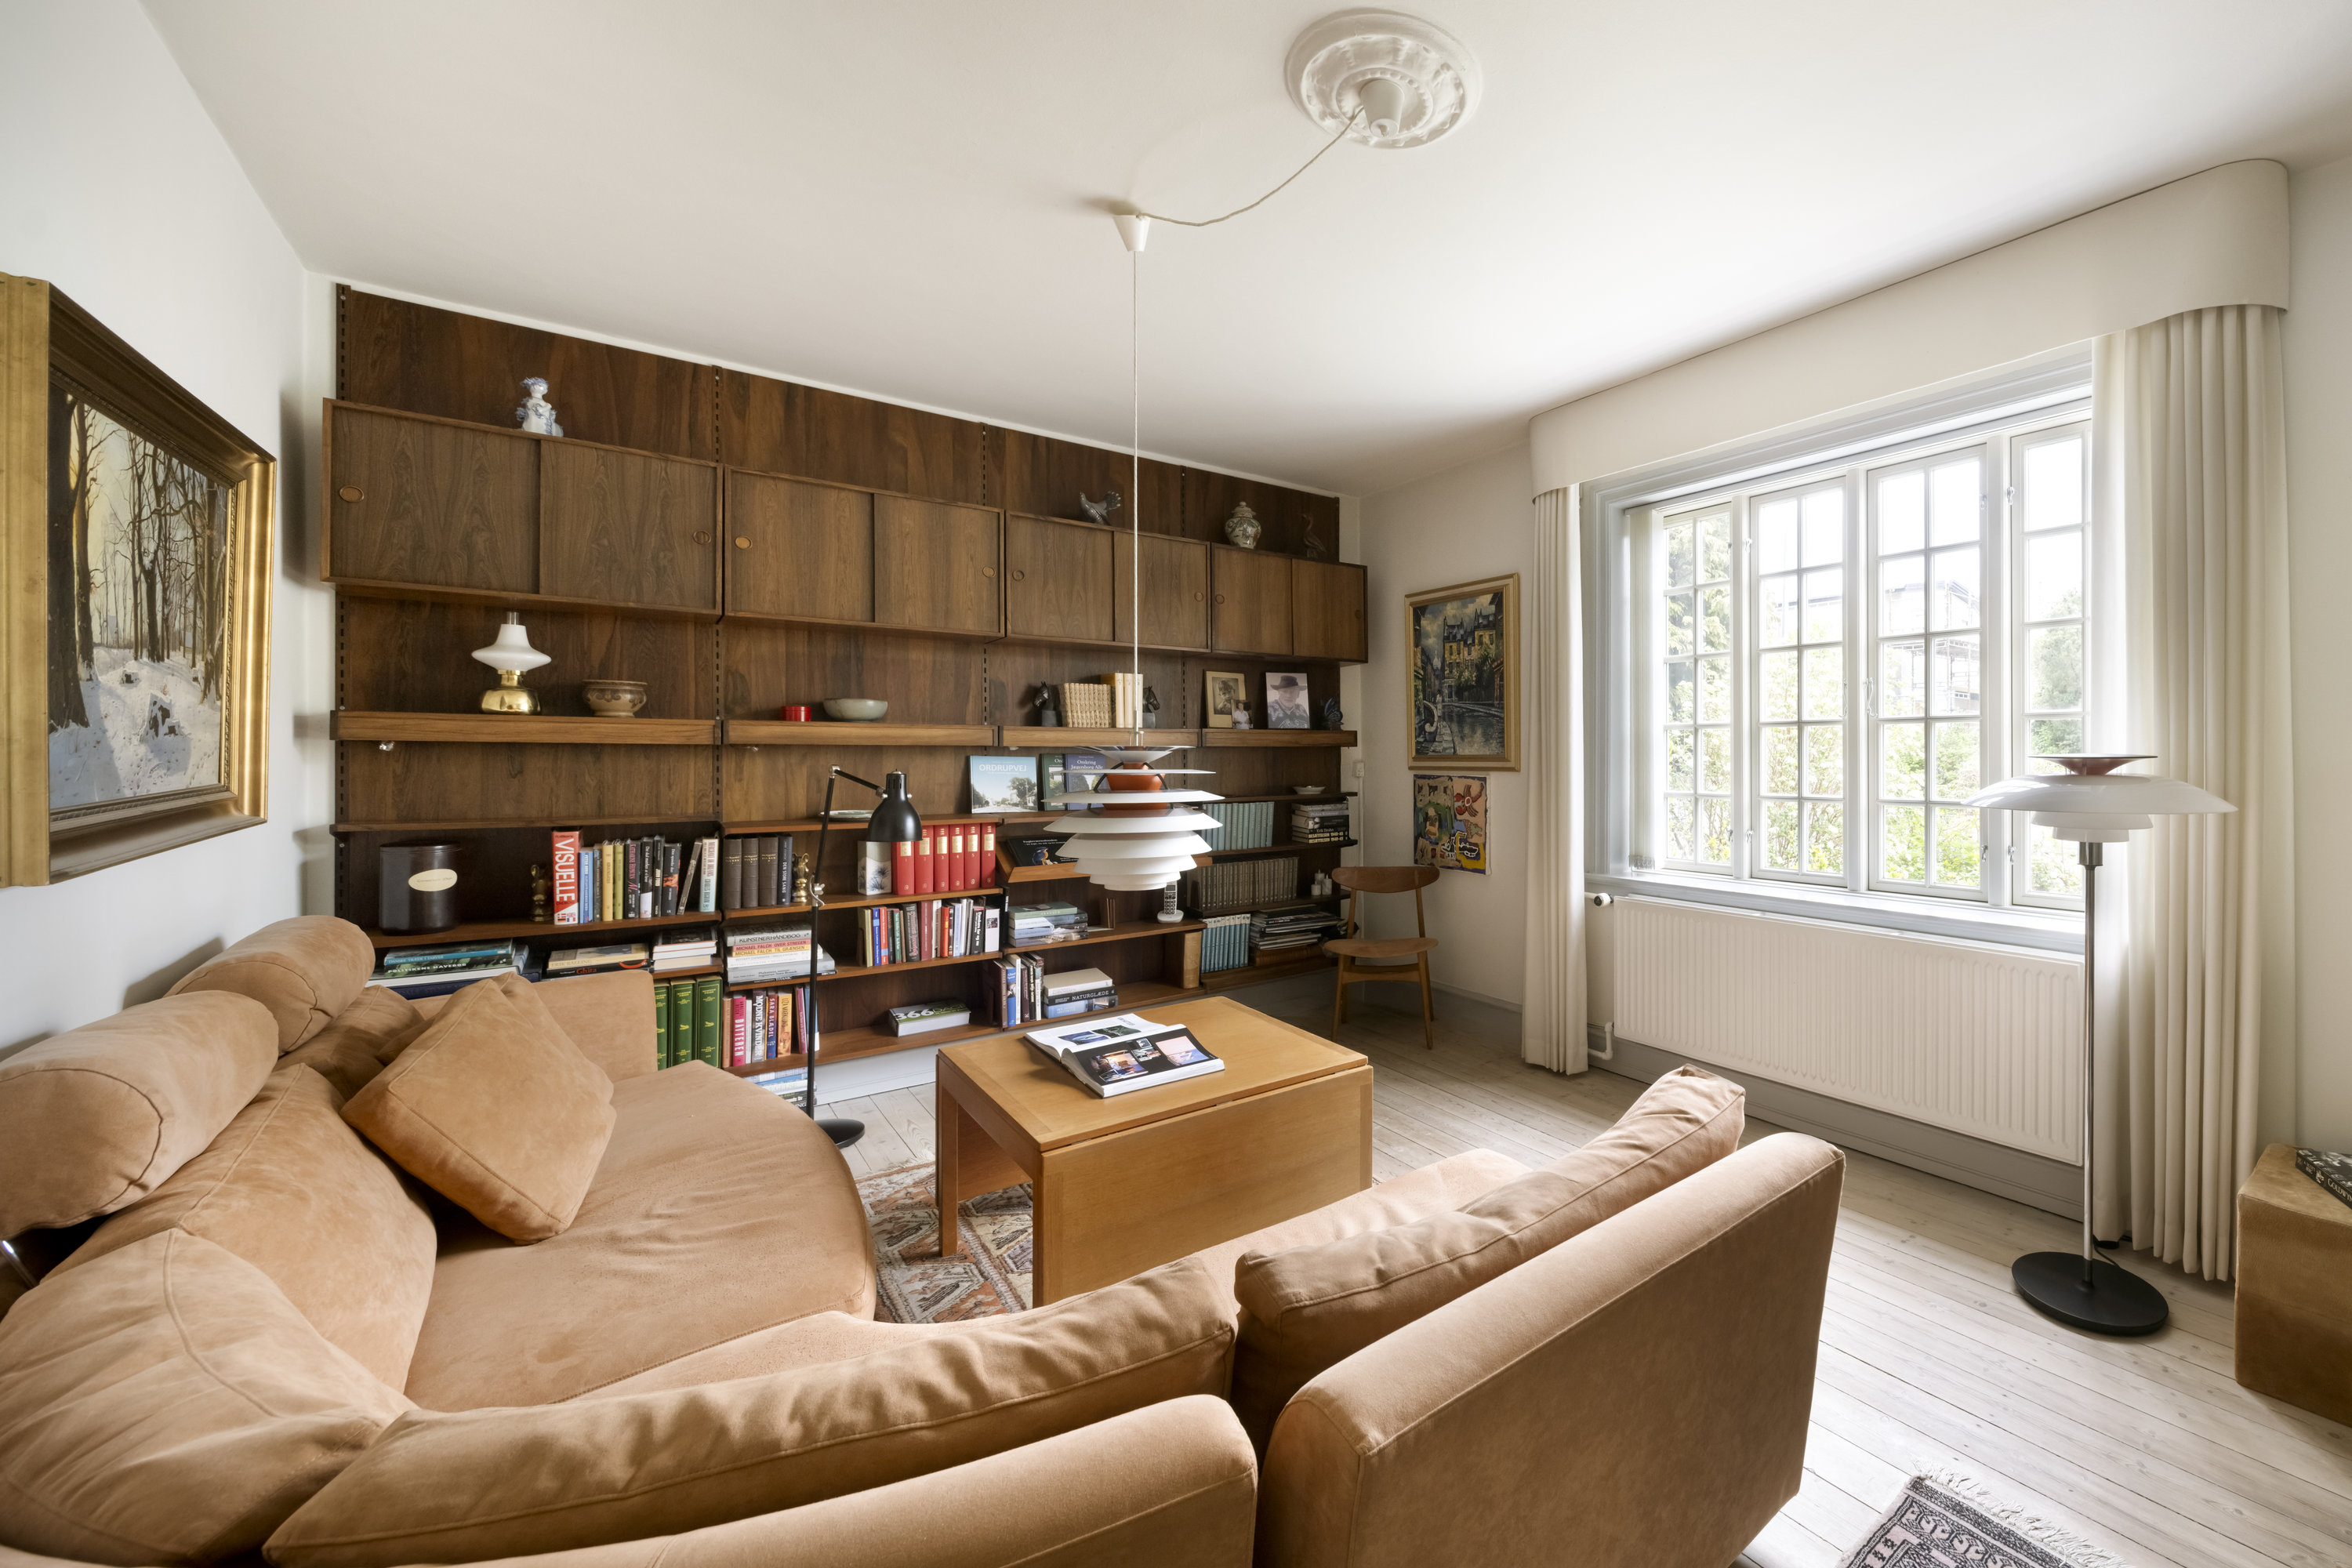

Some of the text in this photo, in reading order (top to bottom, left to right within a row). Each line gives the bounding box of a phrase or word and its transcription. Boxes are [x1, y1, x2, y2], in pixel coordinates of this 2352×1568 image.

[555, 838, 575, 902] VISUELLE
[739, 933, 800, 943] KUNSTNERHÅNDBOG
[1072, 990, 1109, 1000] NATURGLÆDE
[753, 995, 764, 1022] MODNE
[896, 1008, 934, 1020] 366
[735, 1018, 744, 1056] DATTEREN
[2328, 1178, 2352, 1202] GOLDWYN
